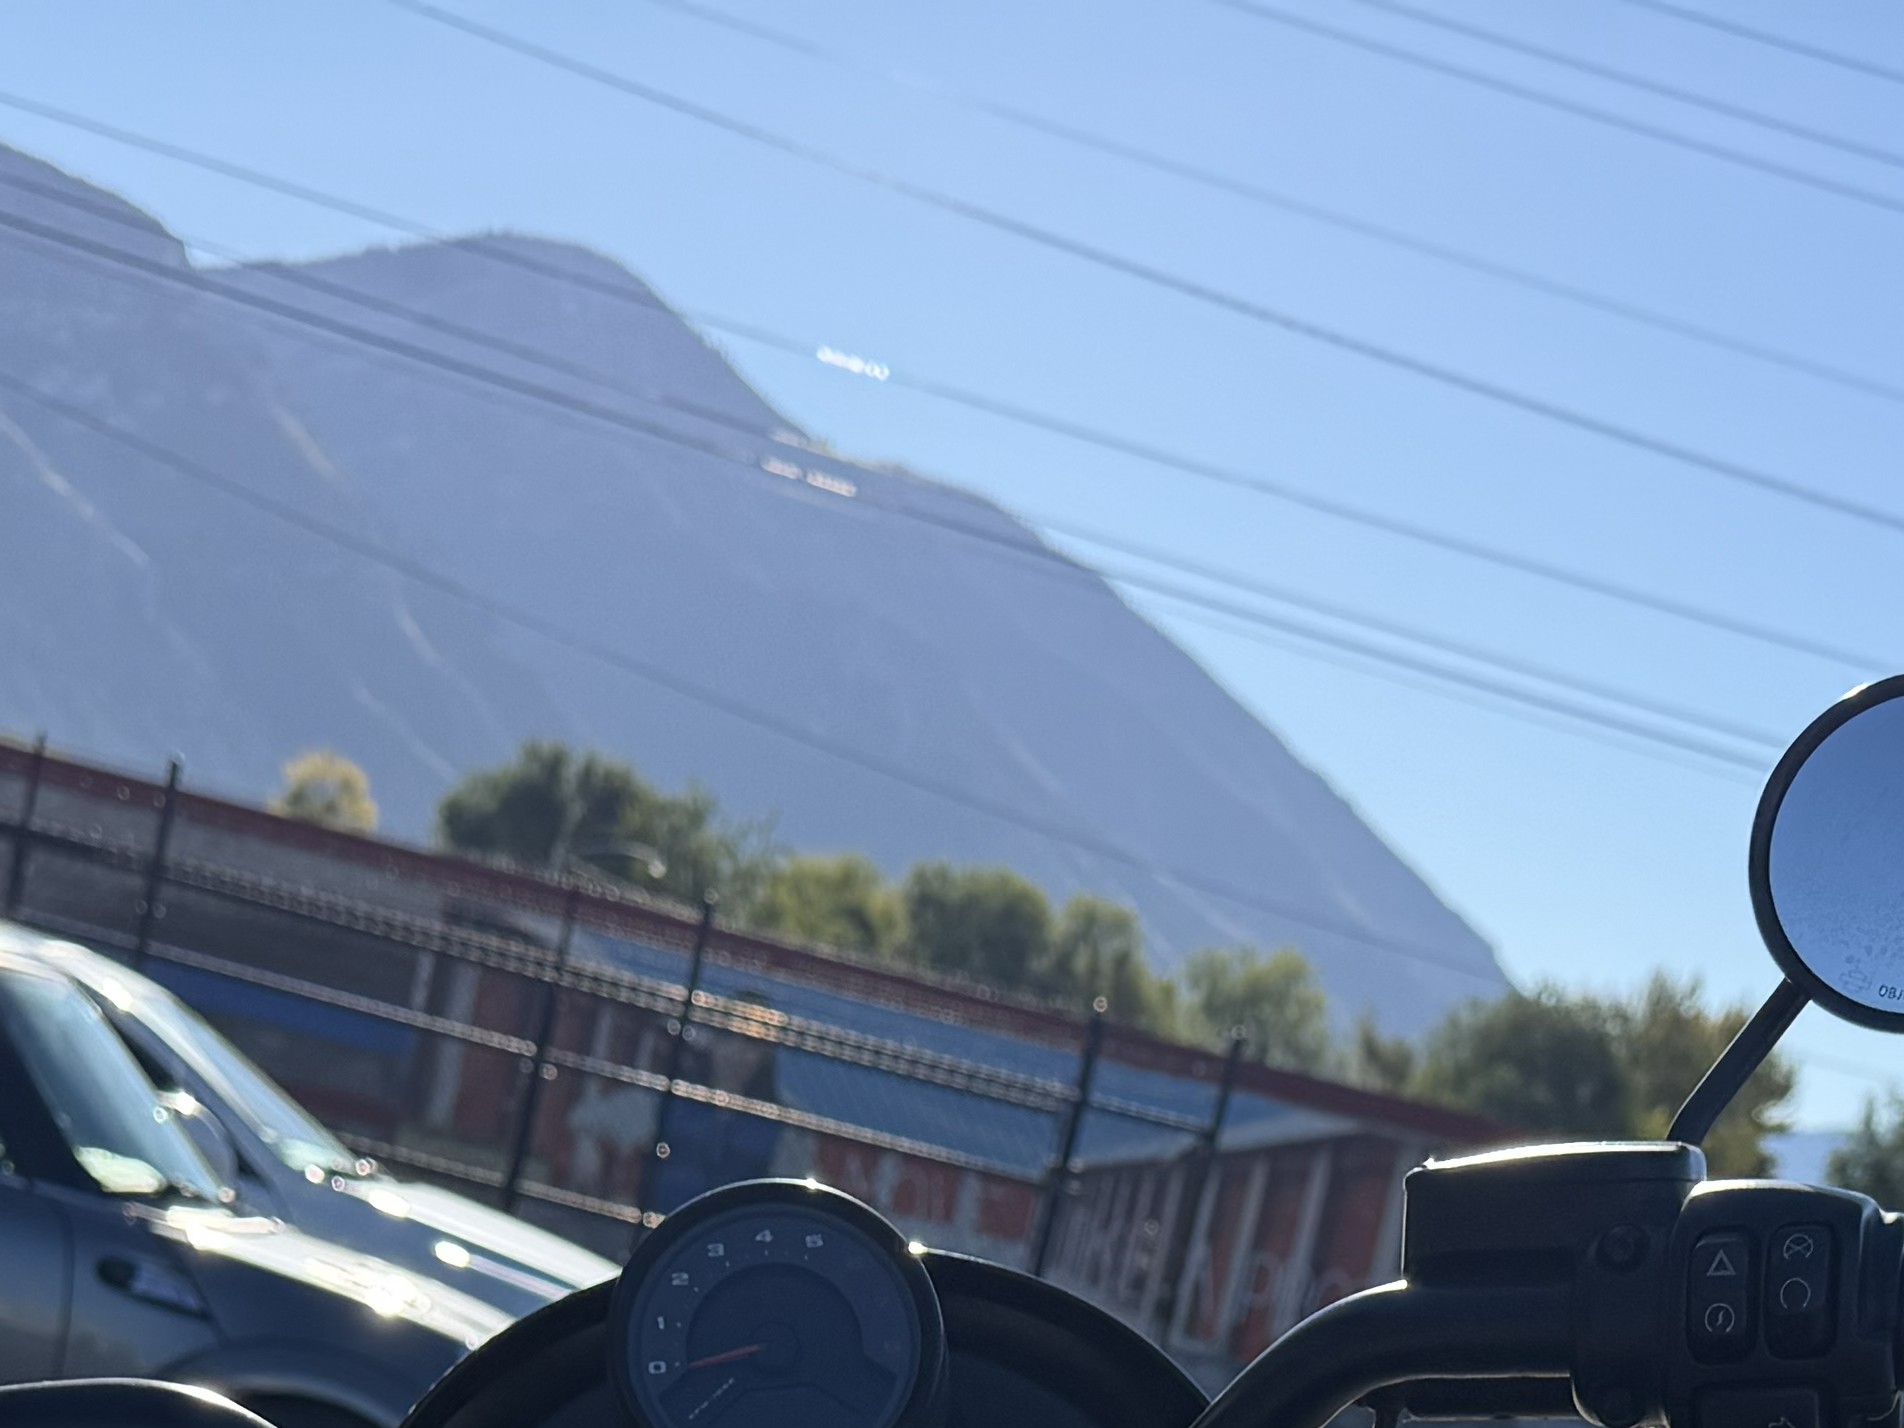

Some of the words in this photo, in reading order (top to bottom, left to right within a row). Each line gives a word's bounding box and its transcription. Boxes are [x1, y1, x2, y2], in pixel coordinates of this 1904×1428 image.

[755, 1229, 773, 1242] 4
[805, 1233, 823, 1248] 5
[707, 1243, 724, 1257] 3
[671, 1272, 689, 1286] 2
[657, 1316, 665, 1330] 1
[648, 1361, 667, 1375] 0
